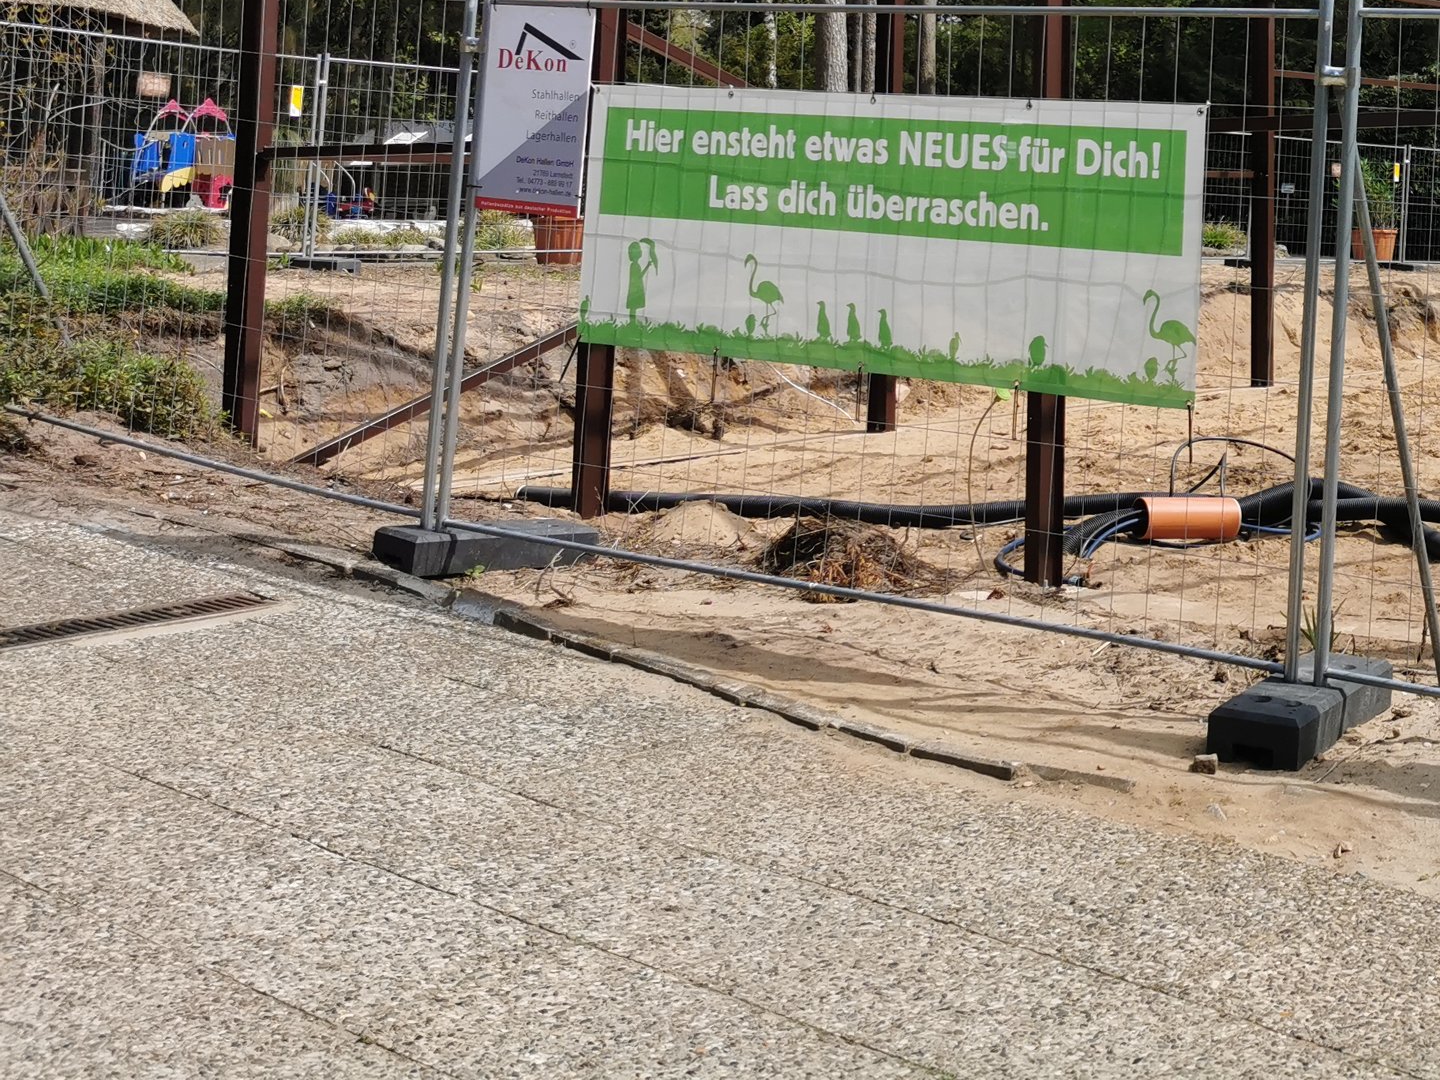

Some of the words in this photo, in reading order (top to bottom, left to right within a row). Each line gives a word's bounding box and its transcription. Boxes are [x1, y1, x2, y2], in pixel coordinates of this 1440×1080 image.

[497, 48, 566, 72] DeKon
[531, 89, 580, 101] Stahlhallen
[534, 110, 579, 122] Reithallen
[526, 130, 577, 143] Lagerhallen
[625, 119, 684, 153] Hier
[692, 124, 796, 159] ensteht
[805, 131, 889, 164] etwas
[899, 130, 1008, 171] NEUES
[1018, 135, 1066, 173] für
[1076, 138, 1161, 179] Dich!
[709, 175, 769, 212] Lass
[777, 179, 836, 216] dich
[847, 184, 1049, 231] überraschen.
